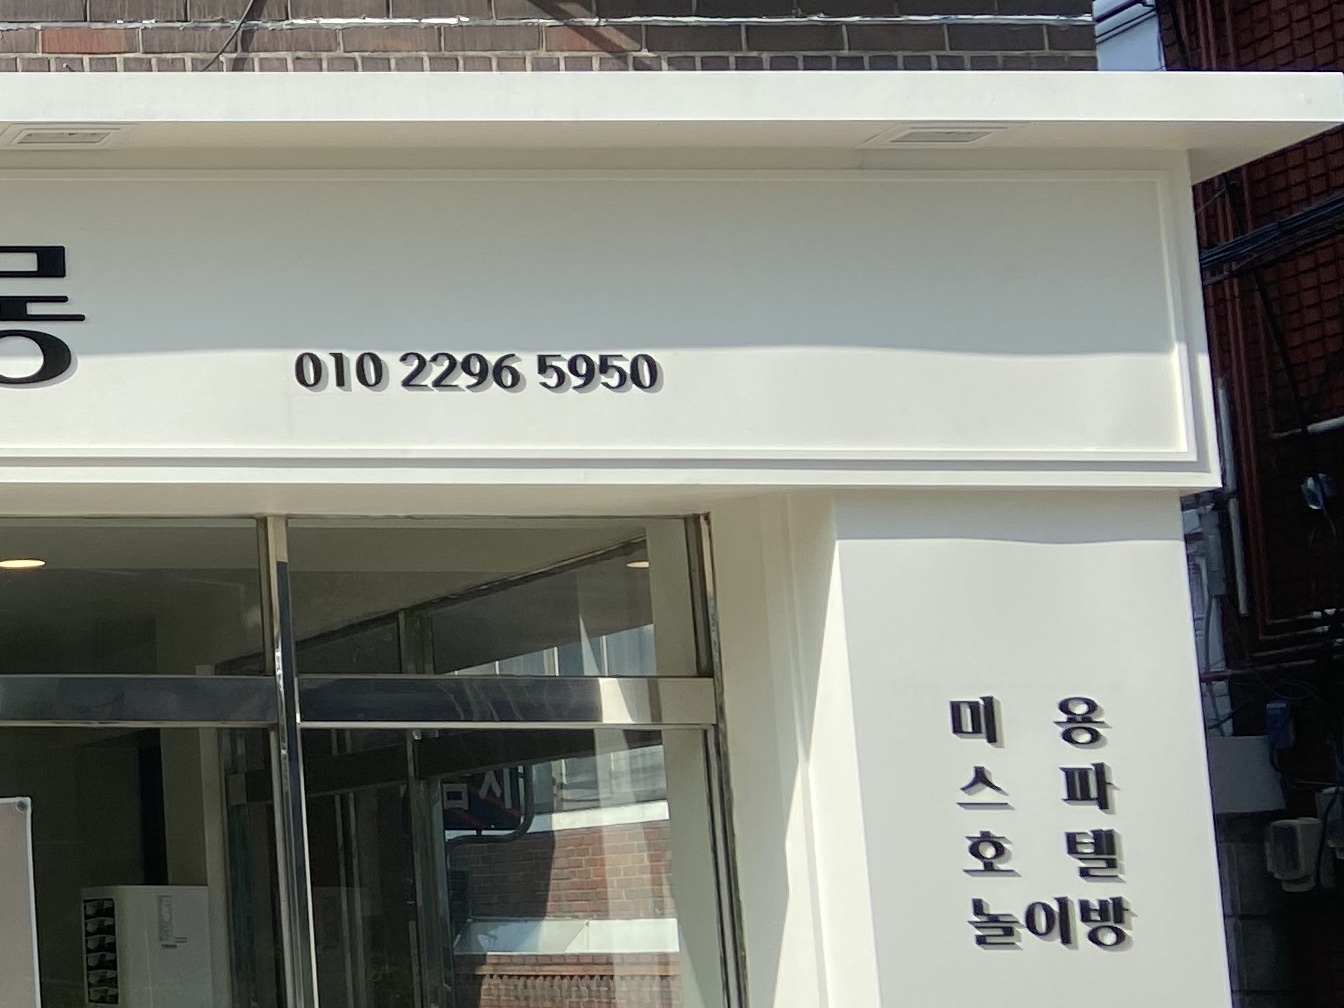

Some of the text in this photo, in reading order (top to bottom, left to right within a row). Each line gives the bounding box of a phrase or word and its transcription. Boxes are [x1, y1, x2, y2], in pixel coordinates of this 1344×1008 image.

[295, 352, 658, 390] 010 2296 5950
[968, 896, 1130, 948] 놀이방
